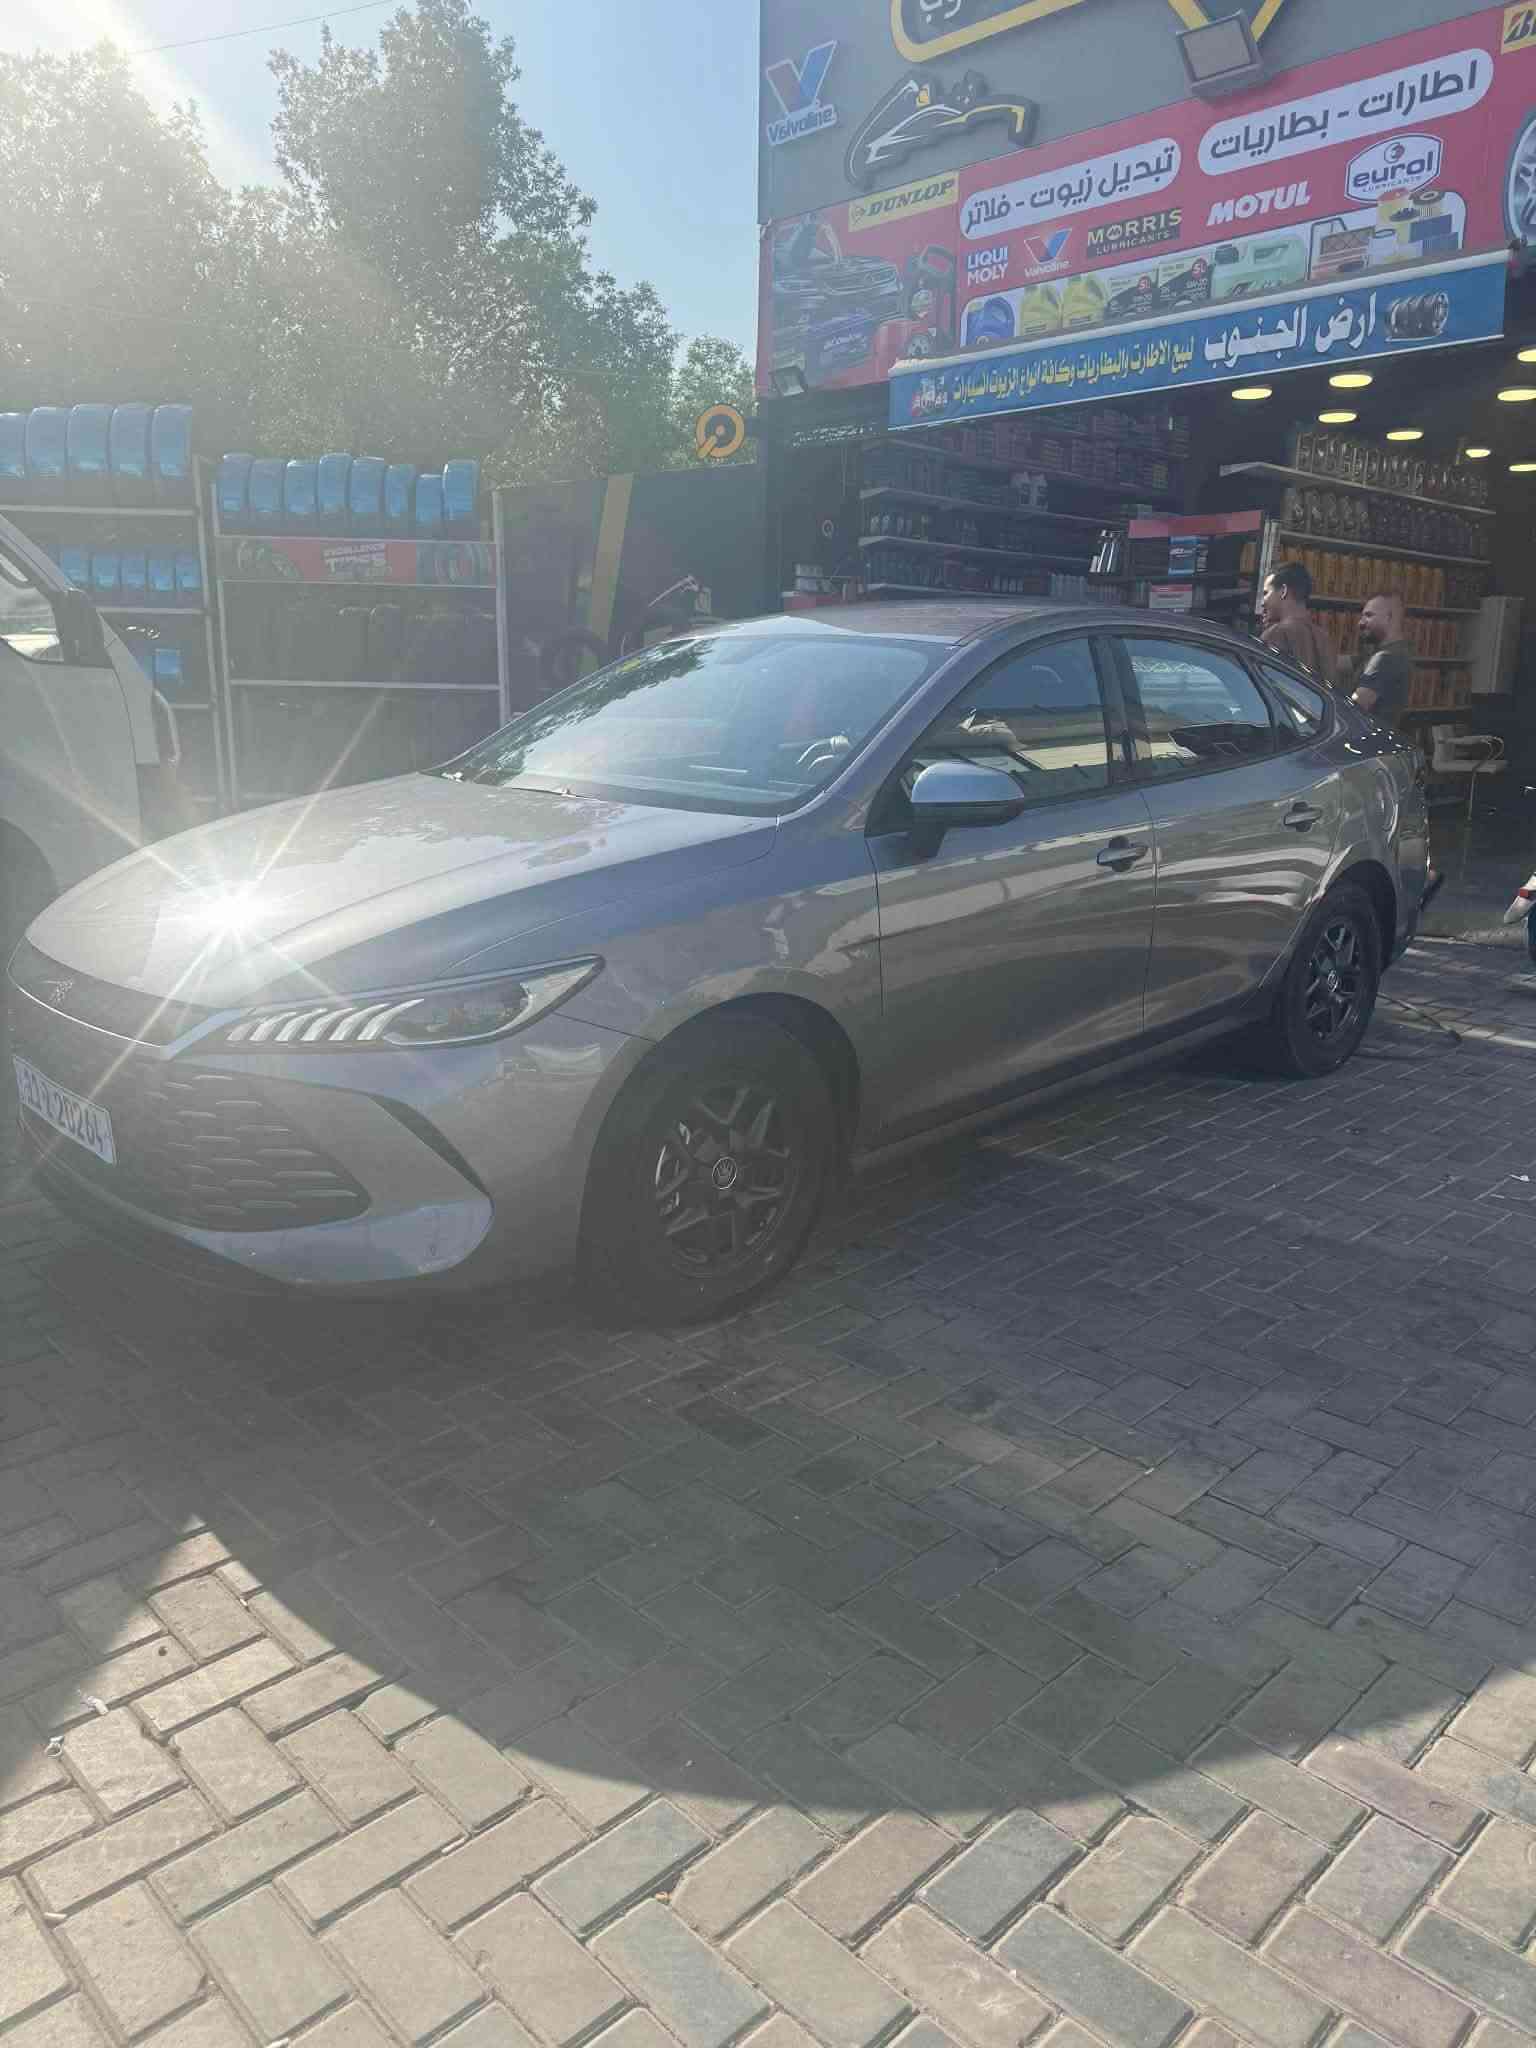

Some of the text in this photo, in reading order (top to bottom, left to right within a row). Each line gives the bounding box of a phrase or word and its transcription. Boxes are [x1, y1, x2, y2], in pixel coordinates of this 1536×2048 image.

[1358, 60, 1477, 118] اطارات
[1210, 110, 1329, 159] بطاريات
[1030, 169, 1094, 208] زيوت
[1098, 146, 1175, 198] تبديل
[1353, 151, 1434, 188] eurol
[865, 178, 956, 217] DUNLOP
[966, 194, 1011, 234] فلاتر
[1206, 181, 1311, 227] MOTUL
[1088, 209, 1183, 247] MORRIS
[967, 246, 1009, 268] LIQUI
[967, 260, 1009, 287] MOLY
[1204, 291, 1377, 369] ارض الجنوب
